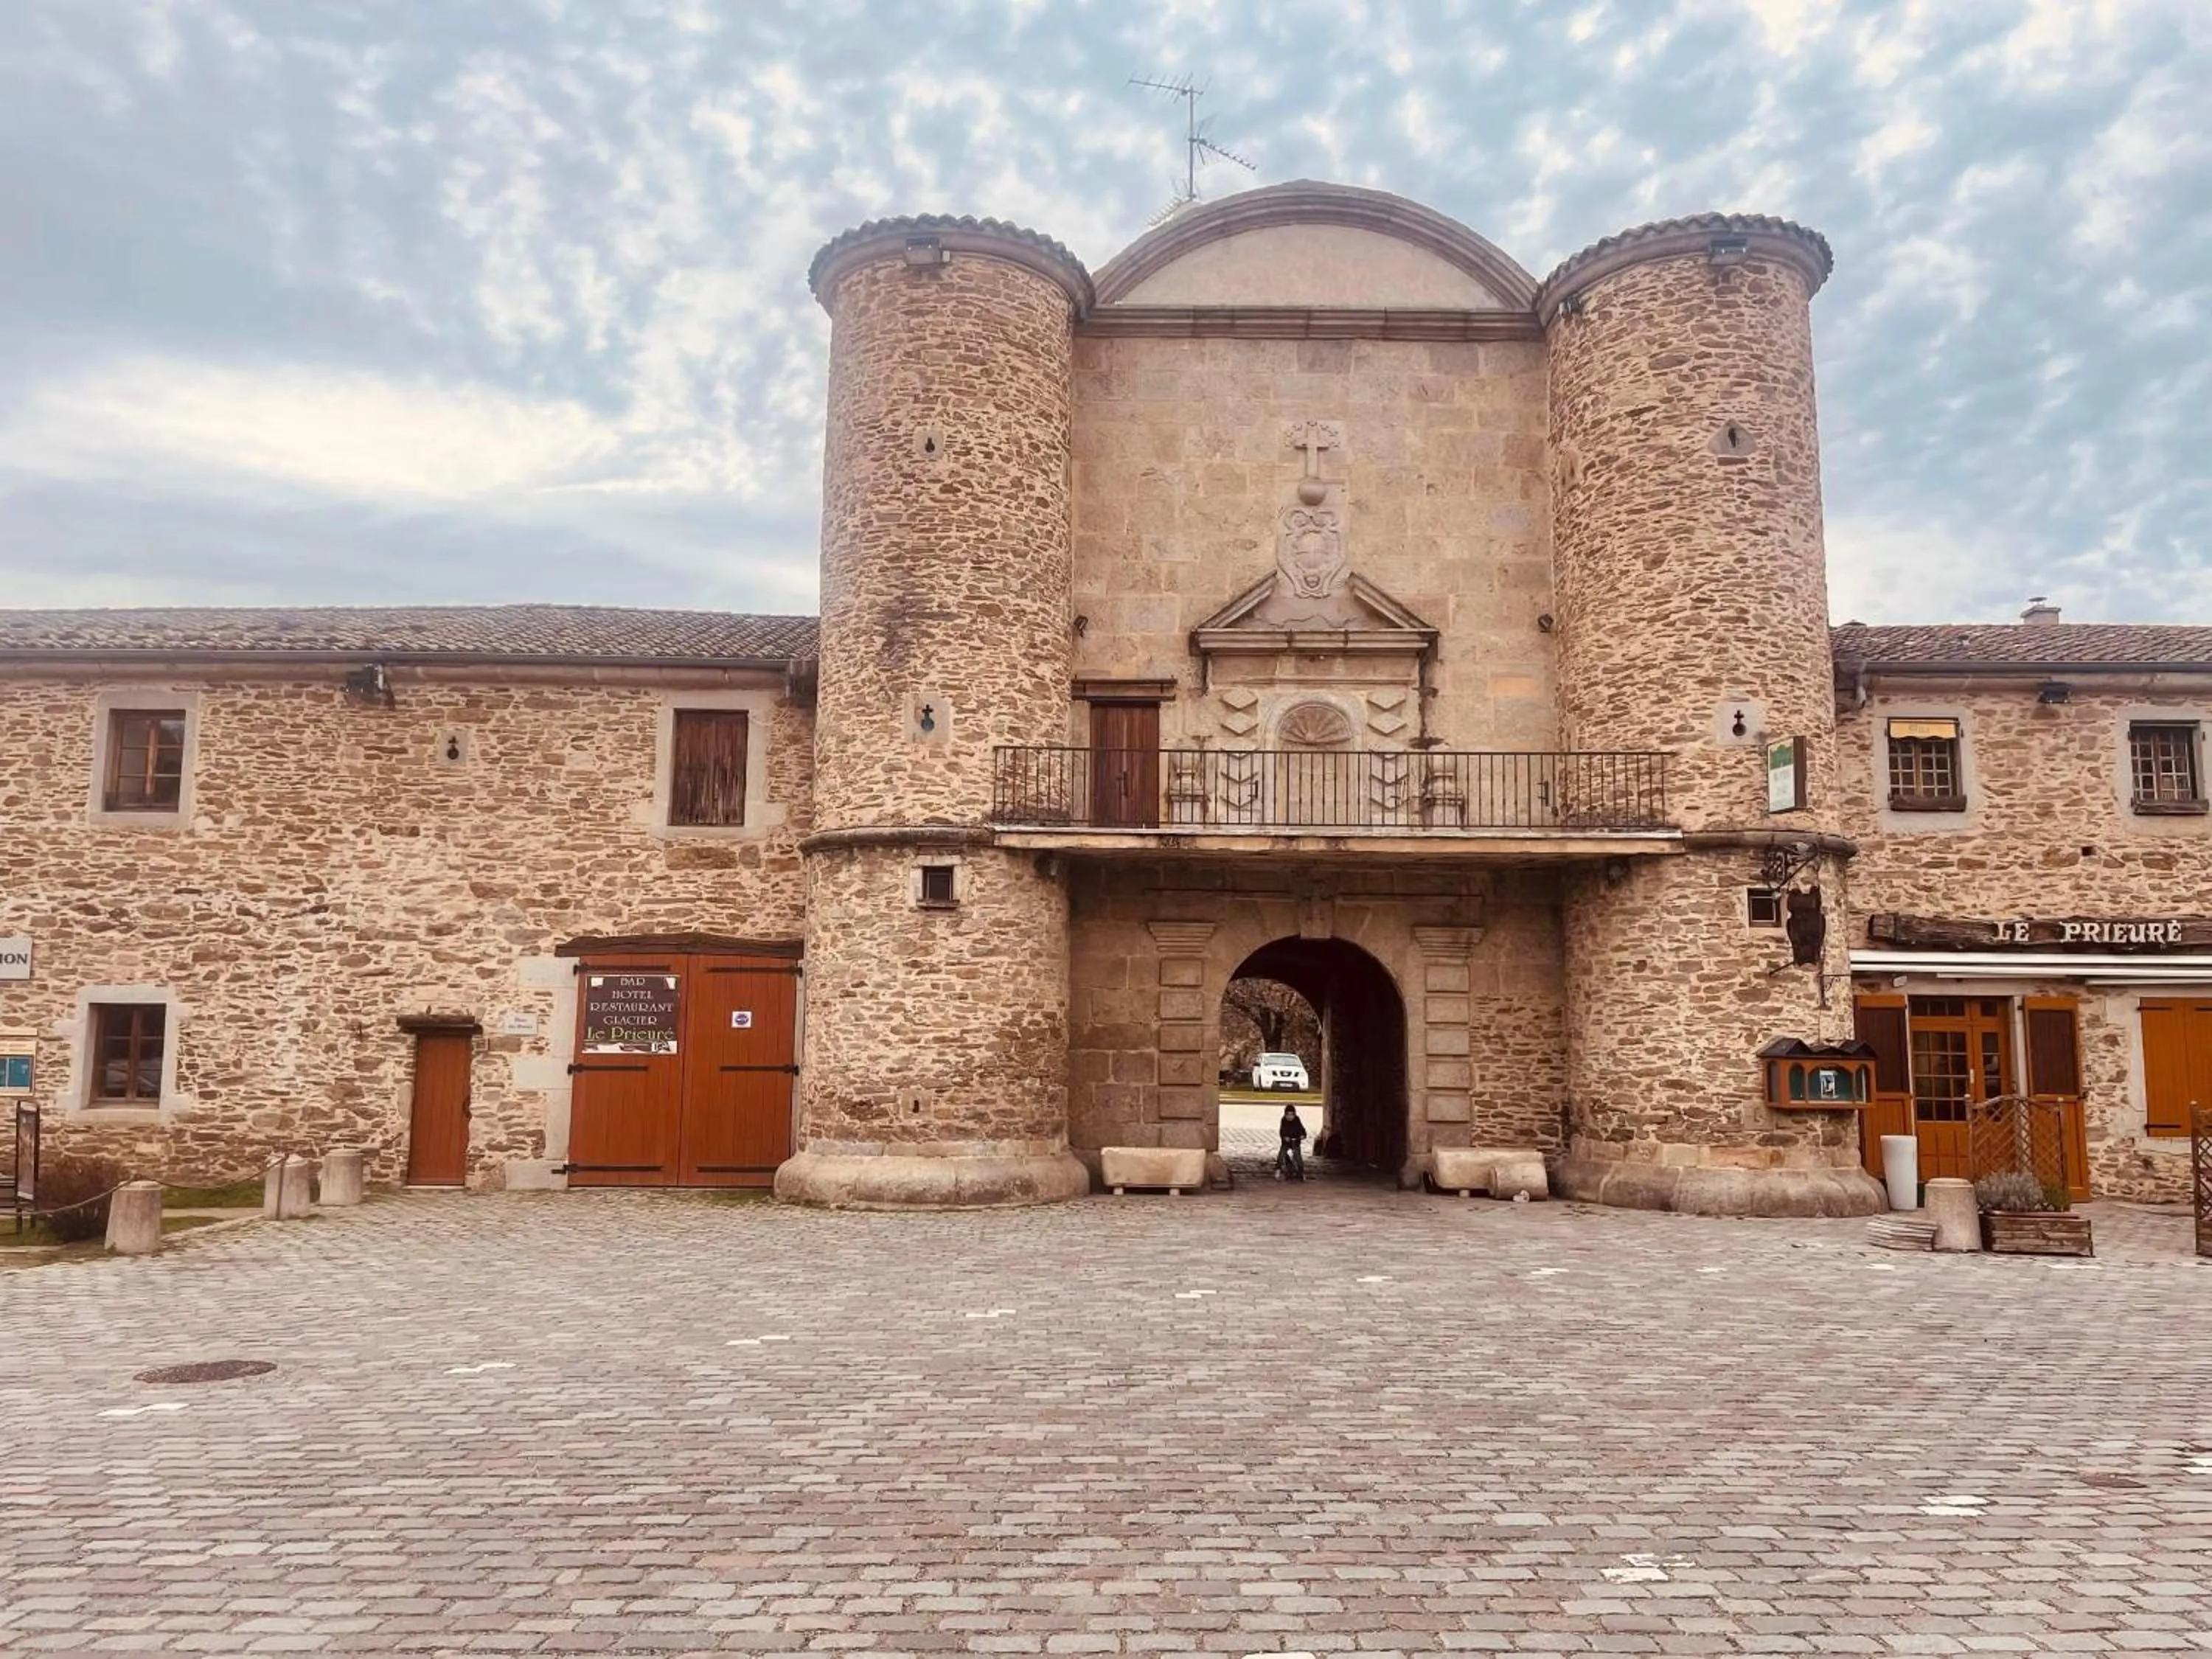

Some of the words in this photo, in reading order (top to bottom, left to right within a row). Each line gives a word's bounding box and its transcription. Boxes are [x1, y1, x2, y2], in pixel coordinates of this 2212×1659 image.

[1992, 921, 2030, 942] LE
[2059, 919, 2183, 944] PRIEURÉ
[620, 977, 645, 986] BAR
[612, 990, 653, 999] HOTEL
[590, 1002, 674, 1012] RESTAURANT
[602, 1015, 658, 1026] GLACIER
[587, 1026, 605, 1039] Le
[611, 1026, 674, 1040] Prieuré
